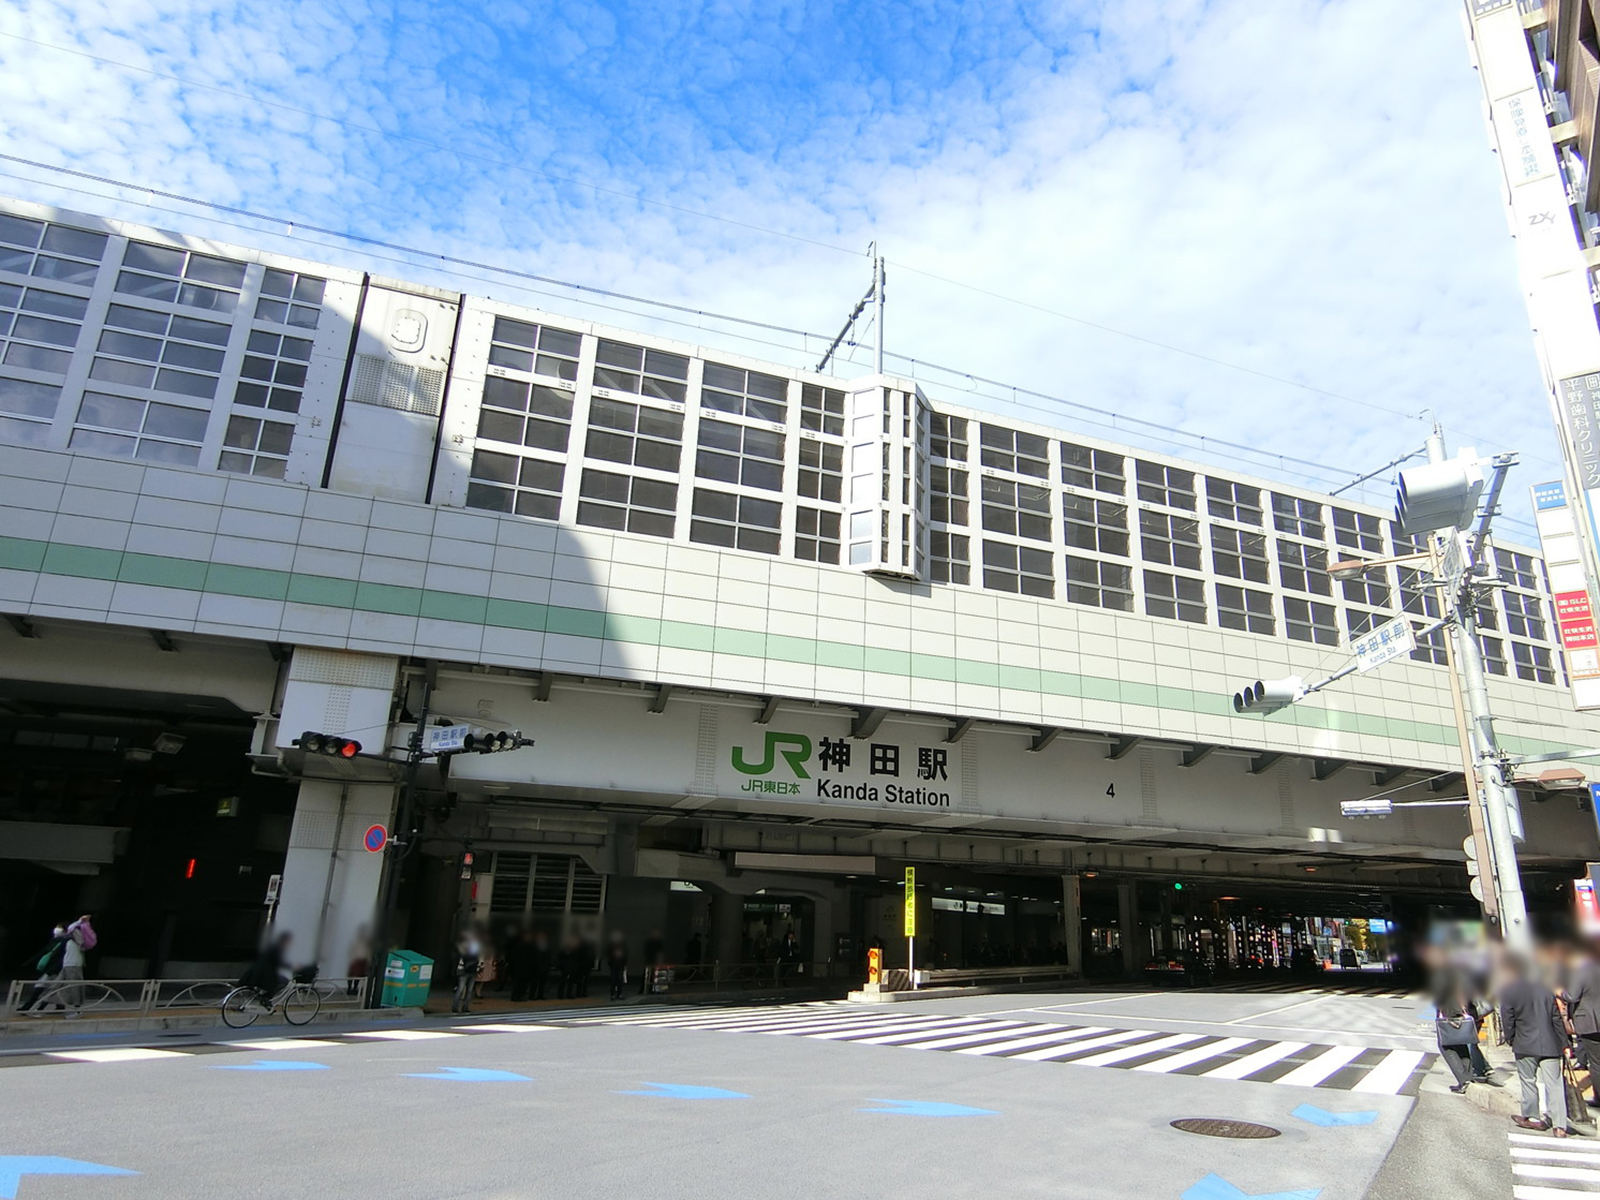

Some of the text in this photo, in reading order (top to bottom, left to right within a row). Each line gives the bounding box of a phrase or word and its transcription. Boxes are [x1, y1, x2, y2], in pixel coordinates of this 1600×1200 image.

[1565, 378, 1600, 486] 平野歯科クリニック
[1356, 622, 1405, 658] 神田駅前
[433, 727, 467, 742] 神田駅前
[731, 731, 812, 780] JR
[818, 737, 949, 781] 神田駅
[741, 779, 801, 796] JR東日本
[817, 778, 950, 807] Kanda Station
[1106, 782, 1116, 799] 4
